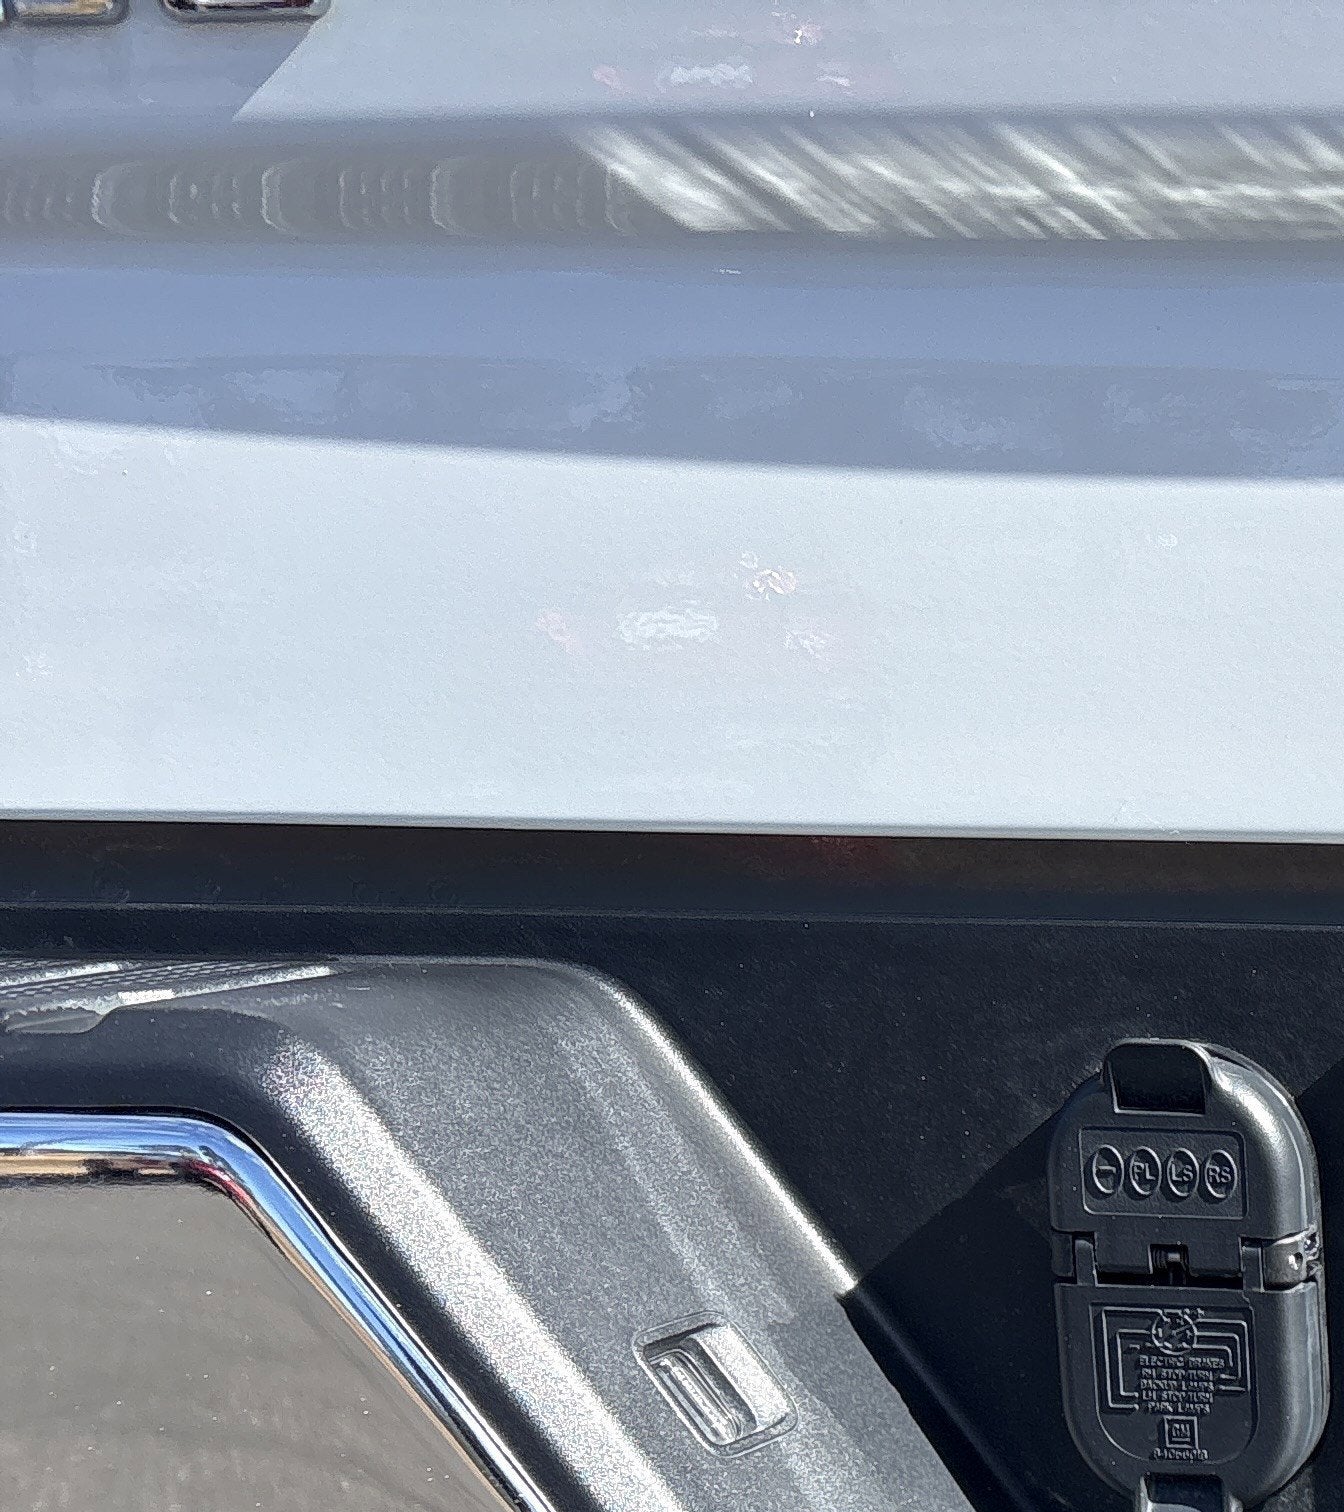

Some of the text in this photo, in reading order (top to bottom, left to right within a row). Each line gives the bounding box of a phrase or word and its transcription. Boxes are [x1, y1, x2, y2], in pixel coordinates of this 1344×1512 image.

[1133, 1161, 1156, 1181] PL
[1171, 1163, 1194, 1182] LS
[1207, 1164, 1232, 1183] RS
